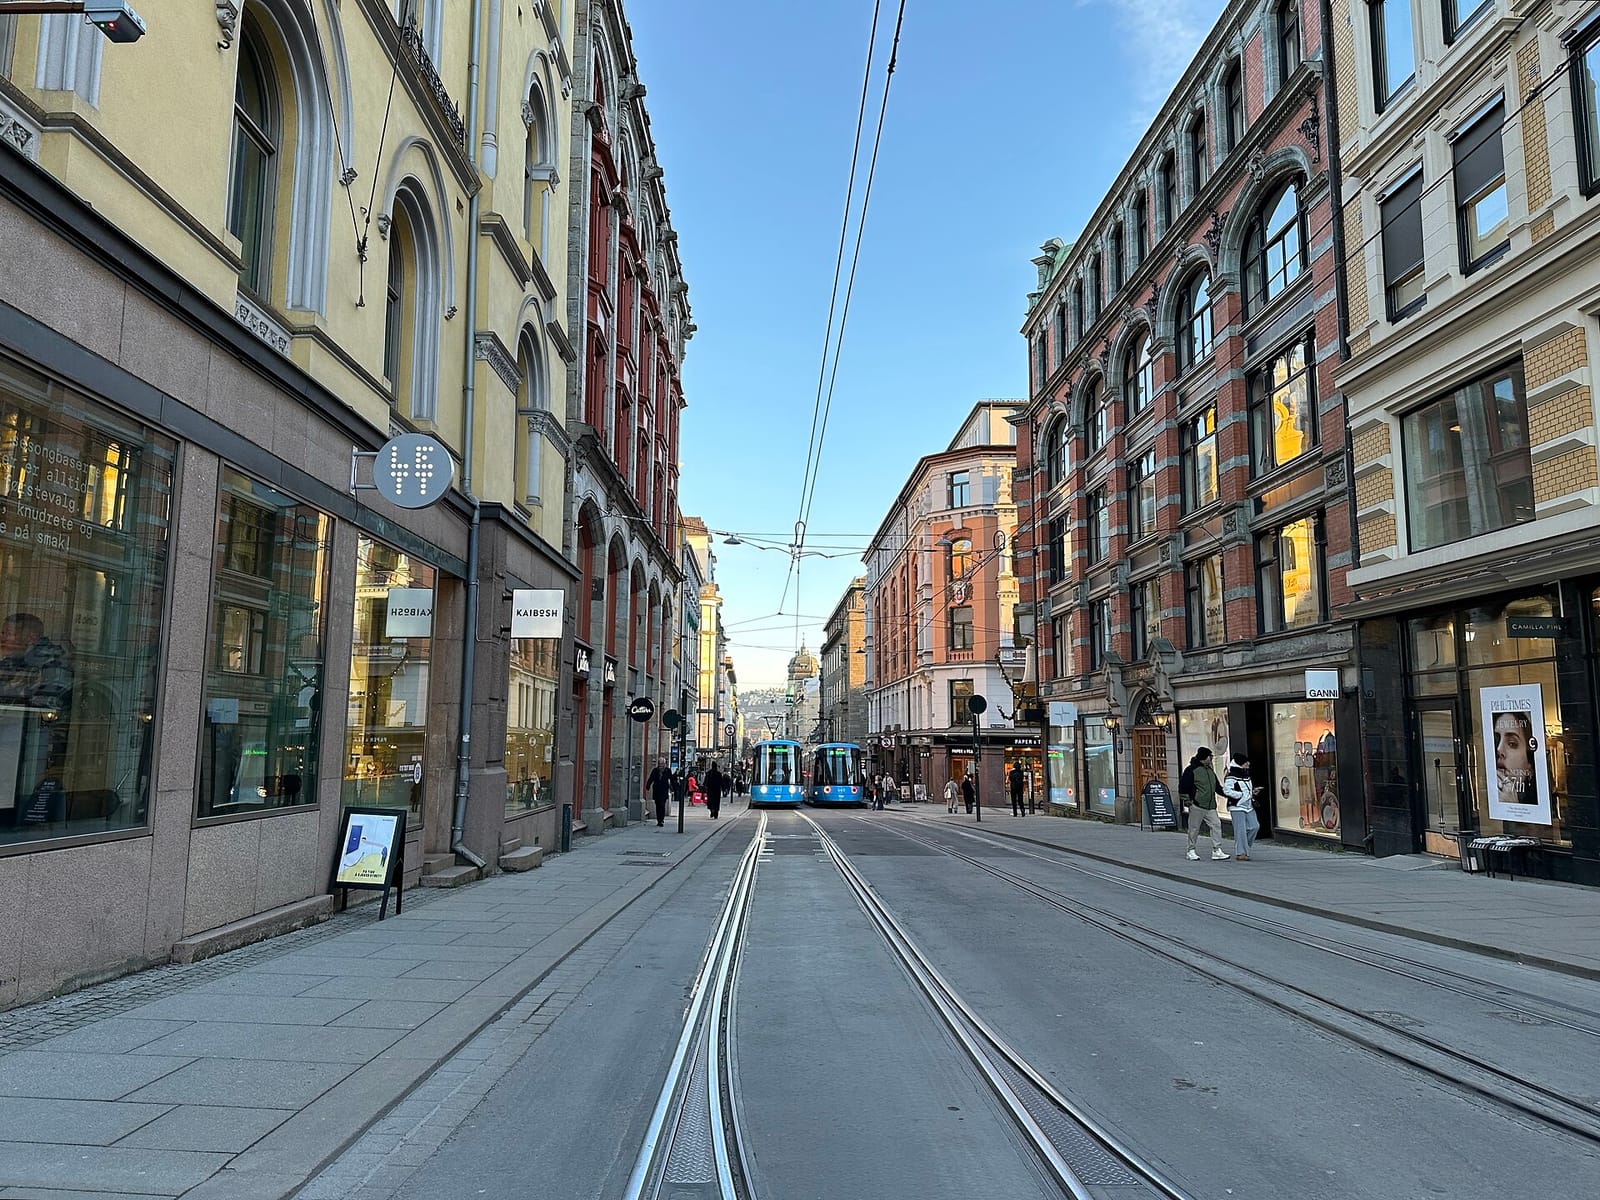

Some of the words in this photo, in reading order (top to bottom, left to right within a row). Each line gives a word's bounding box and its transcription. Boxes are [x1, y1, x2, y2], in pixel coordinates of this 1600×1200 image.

[12, 437, 101, 478] sesongbasere
[25, 462, 40, 477] er
[46, 469, 88, 494] alltid
[17, 503, 74, 531] knudrete
[79, 524, 93, 539] og
[14, 524, 30, 540] på
[37, 531, 71, 552] smak!
[516, 608, 558, 617] KAIBOSH
[1309, 689, 1338, 698] GANNI
[1507, 698, 1531, 711] TIMES
